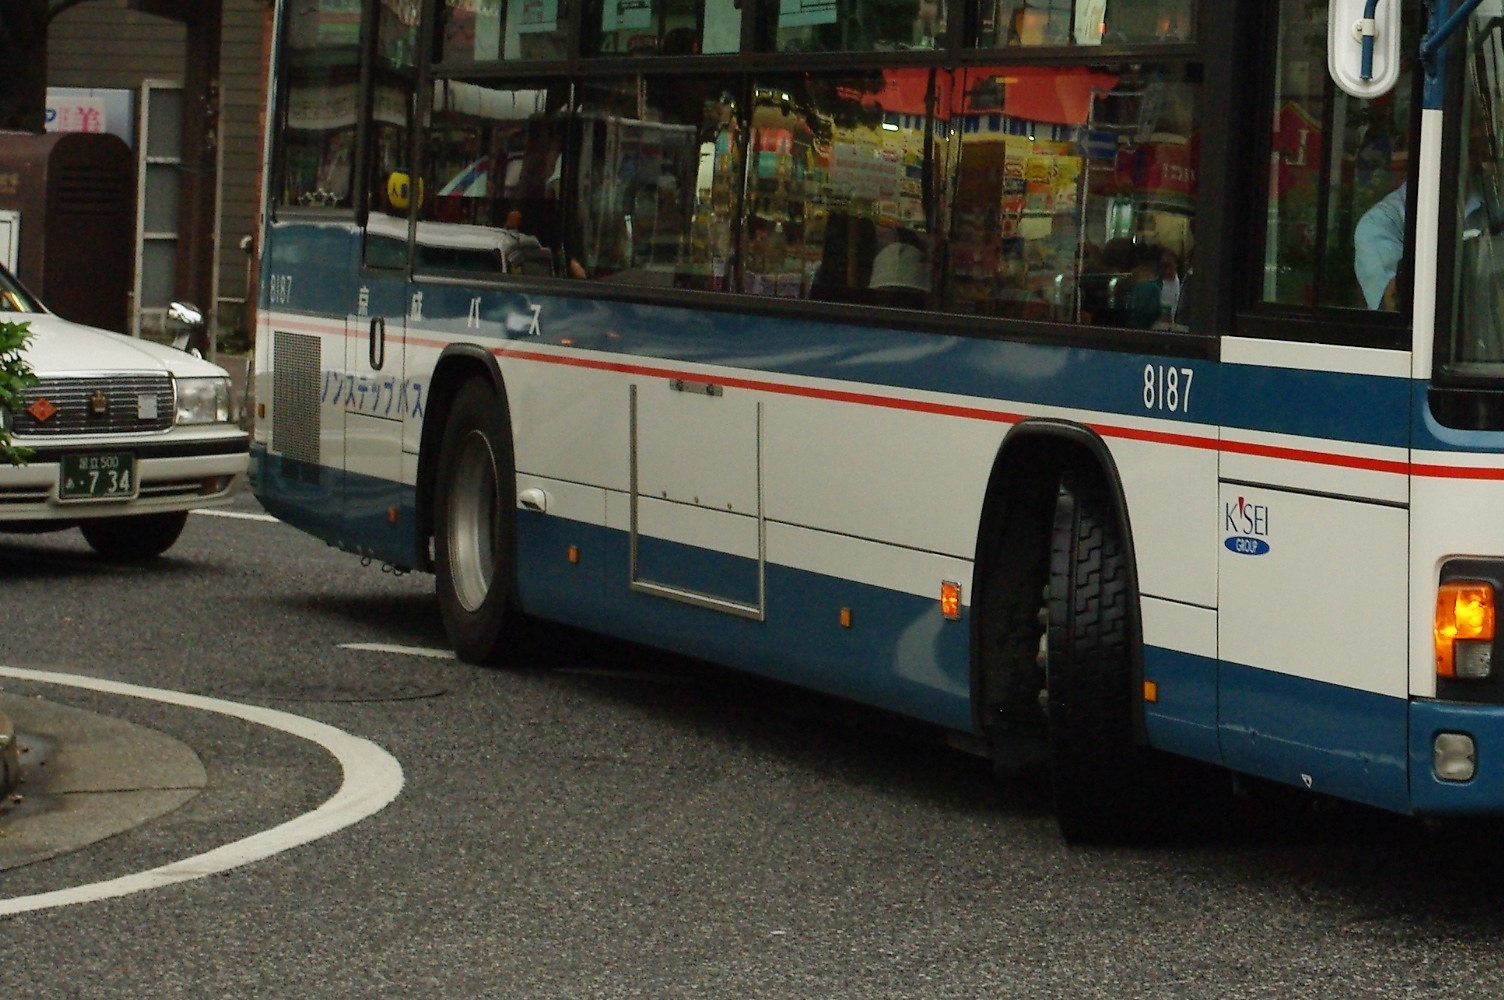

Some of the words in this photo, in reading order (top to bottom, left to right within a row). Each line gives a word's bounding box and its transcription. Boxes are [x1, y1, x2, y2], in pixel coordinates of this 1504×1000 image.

[268, 274, 293, 304] 8187
[1142, 363, 1195, 413] 8187
[1235, 537, 1259, 555] GROUP
